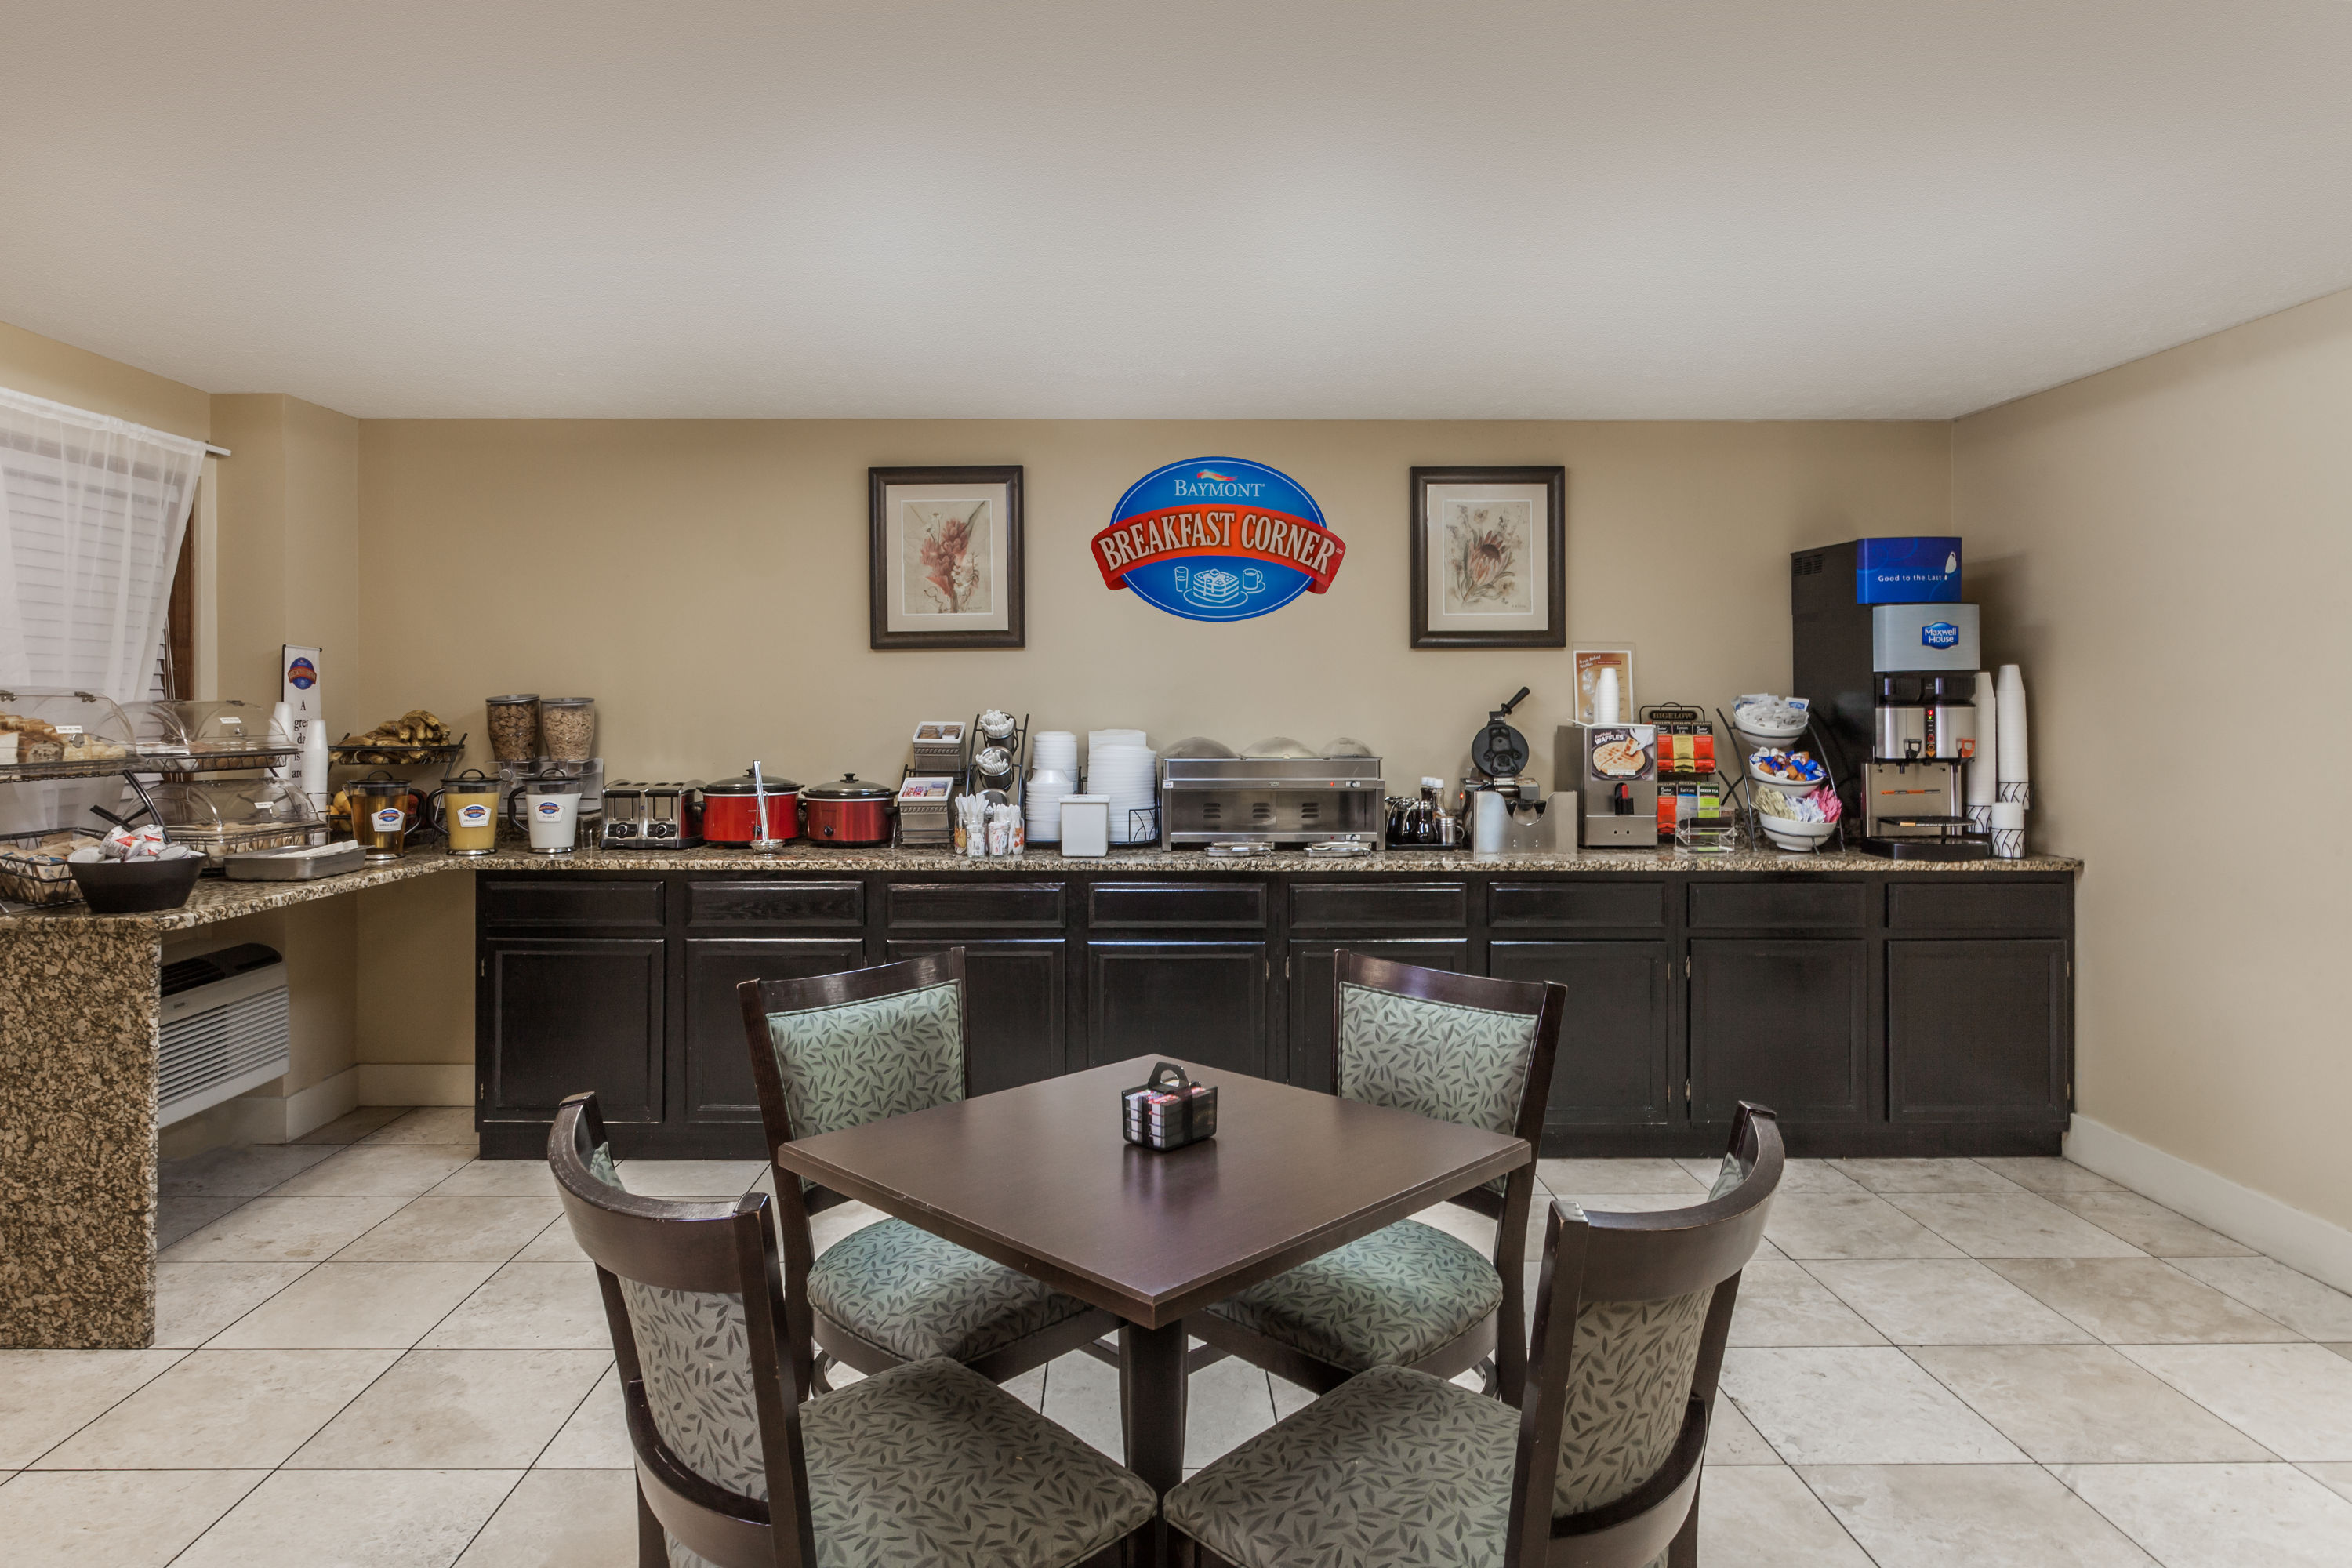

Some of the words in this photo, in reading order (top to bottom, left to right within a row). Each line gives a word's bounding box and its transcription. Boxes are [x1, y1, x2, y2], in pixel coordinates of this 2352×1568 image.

[1174, 479, 1262, 498] BAYMONT
[1098, 511, 1236, 572] BREAKFAST
[1240, 514, 1336, 575] CORNER
[1924, 627, 1957, 637] Maxwell
[300, 699, 307, 711] A
[1594, 734, 1624, 745] WAFFLES
